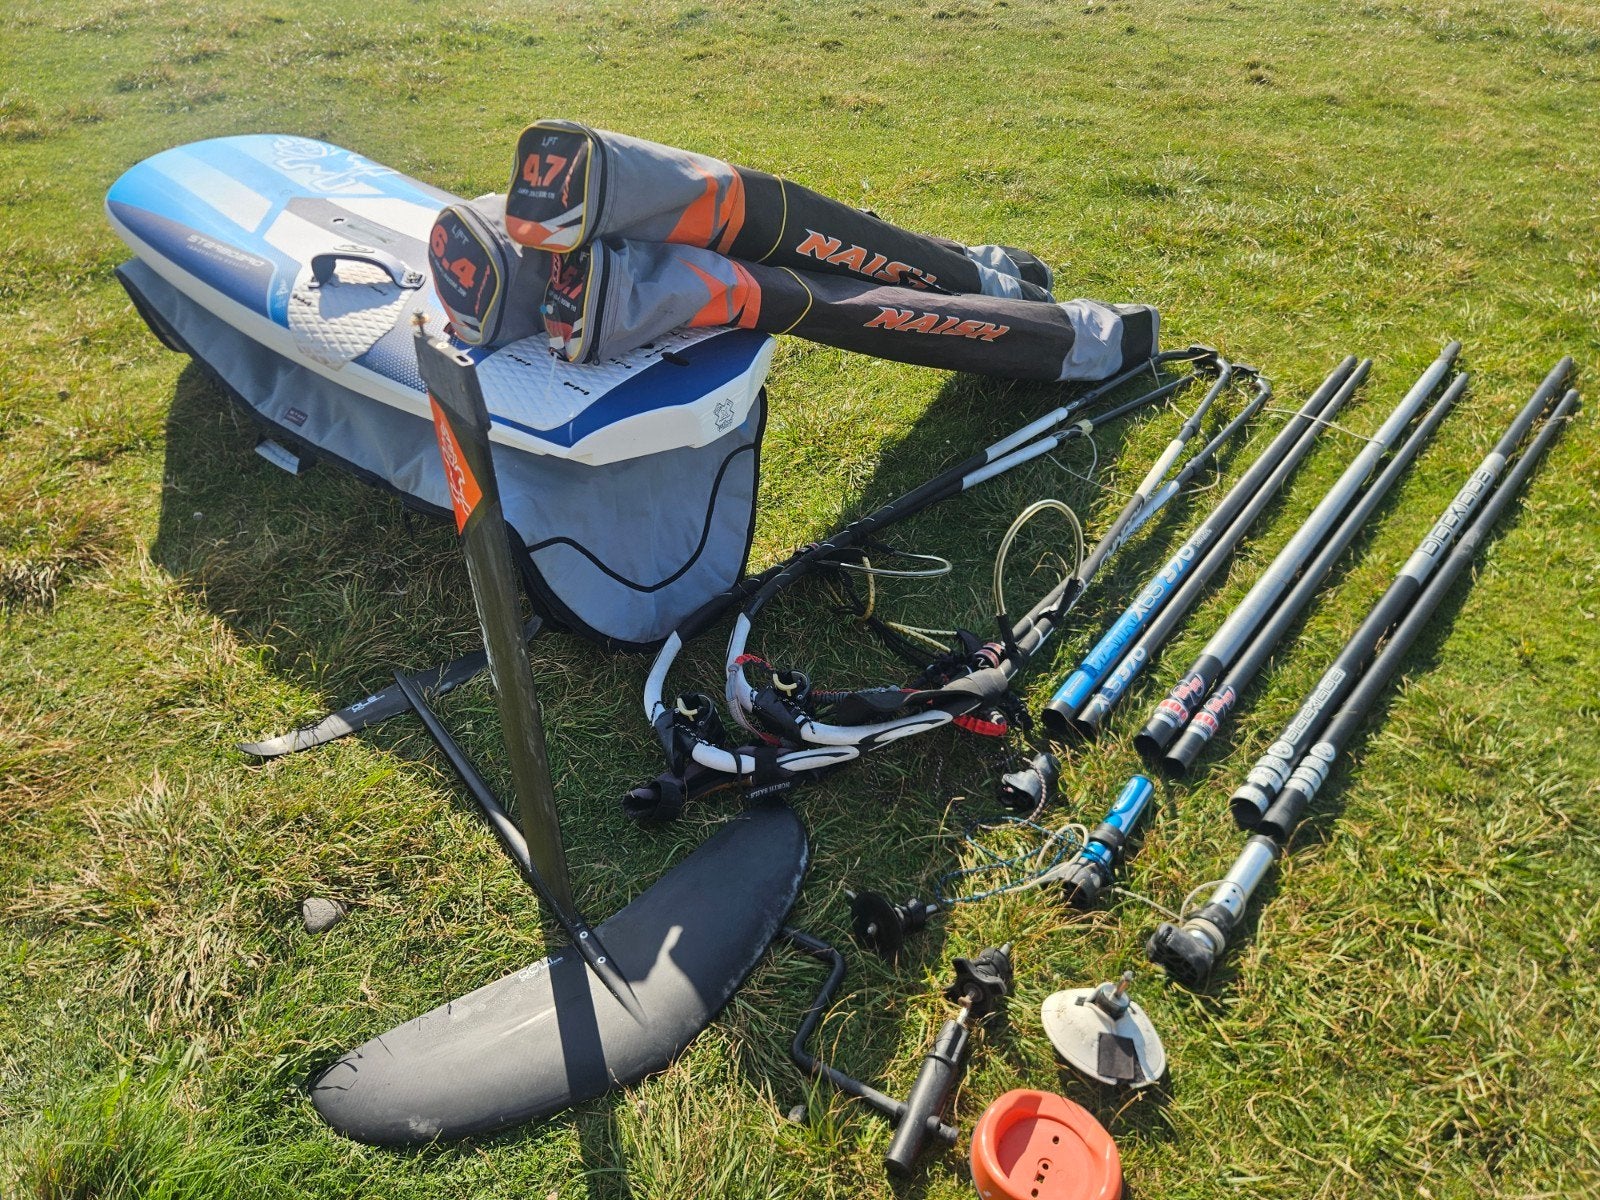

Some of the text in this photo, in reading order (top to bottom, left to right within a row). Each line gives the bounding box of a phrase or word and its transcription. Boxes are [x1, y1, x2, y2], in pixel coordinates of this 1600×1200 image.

[523, 153, 568, 187] 4.7
[431, 224, 477, 288] 6.4
[863, 306, 1010, 342] NAISH
